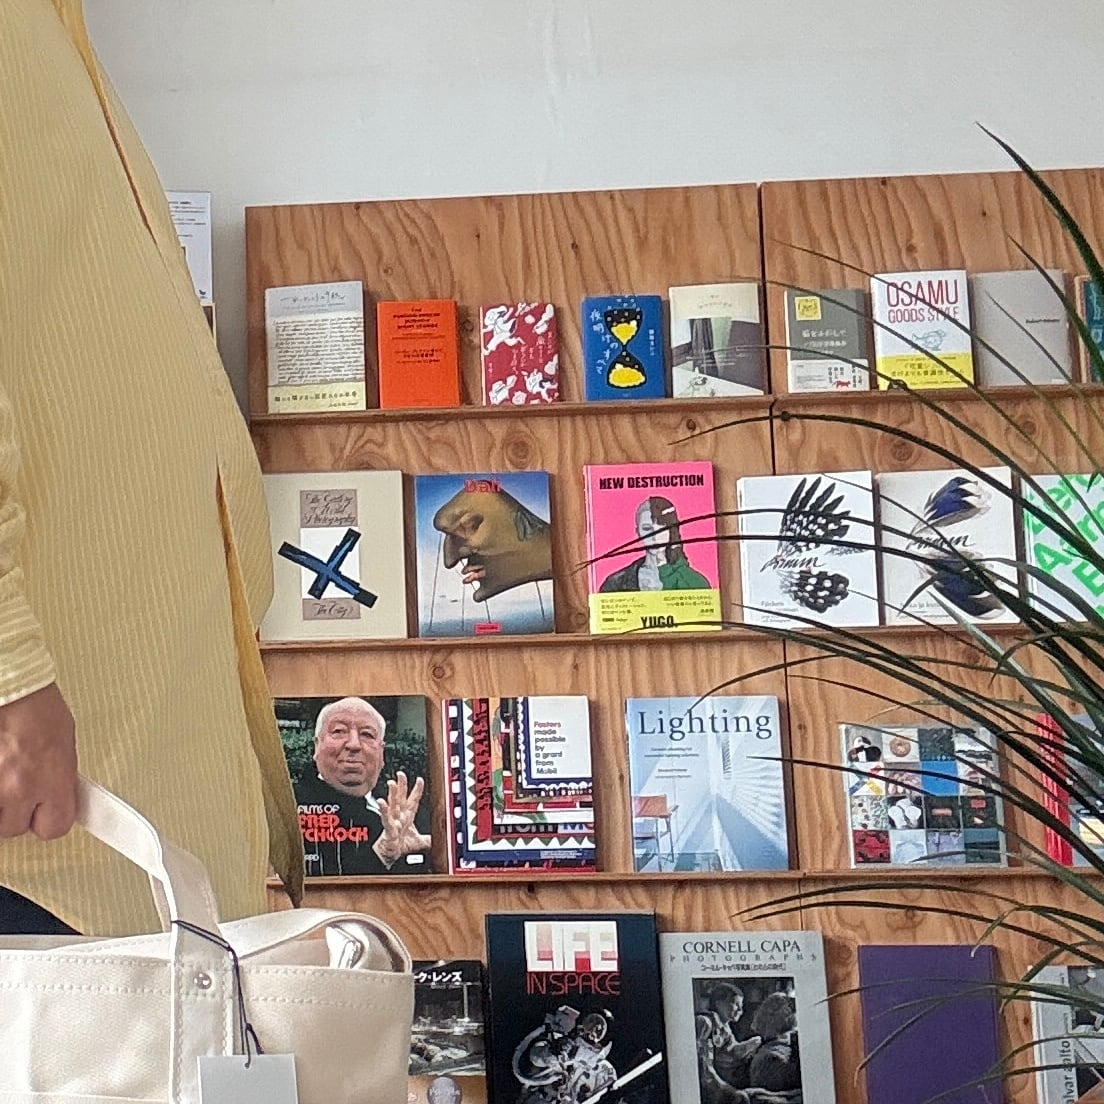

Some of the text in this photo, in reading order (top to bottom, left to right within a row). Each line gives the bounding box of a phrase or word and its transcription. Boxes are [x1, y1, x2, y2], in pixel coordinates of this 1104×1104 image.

[887, 280, 959, 307] OSAMU
[888, 308, 925, 323] GOODS
[599, 474, 704, 489] NEW DESTRUCTION
[638, 708, 772, 741] Lighting
[535, 735, 566, 744] possible
[535, 744, 545, 752] by
[323, 804, 340, 814] OF
[525, 921, 619, 972] LIFE
[682, 939, 801, 954] CORNELL CAPA
[526, 972, 621, 996] IN SPACE
